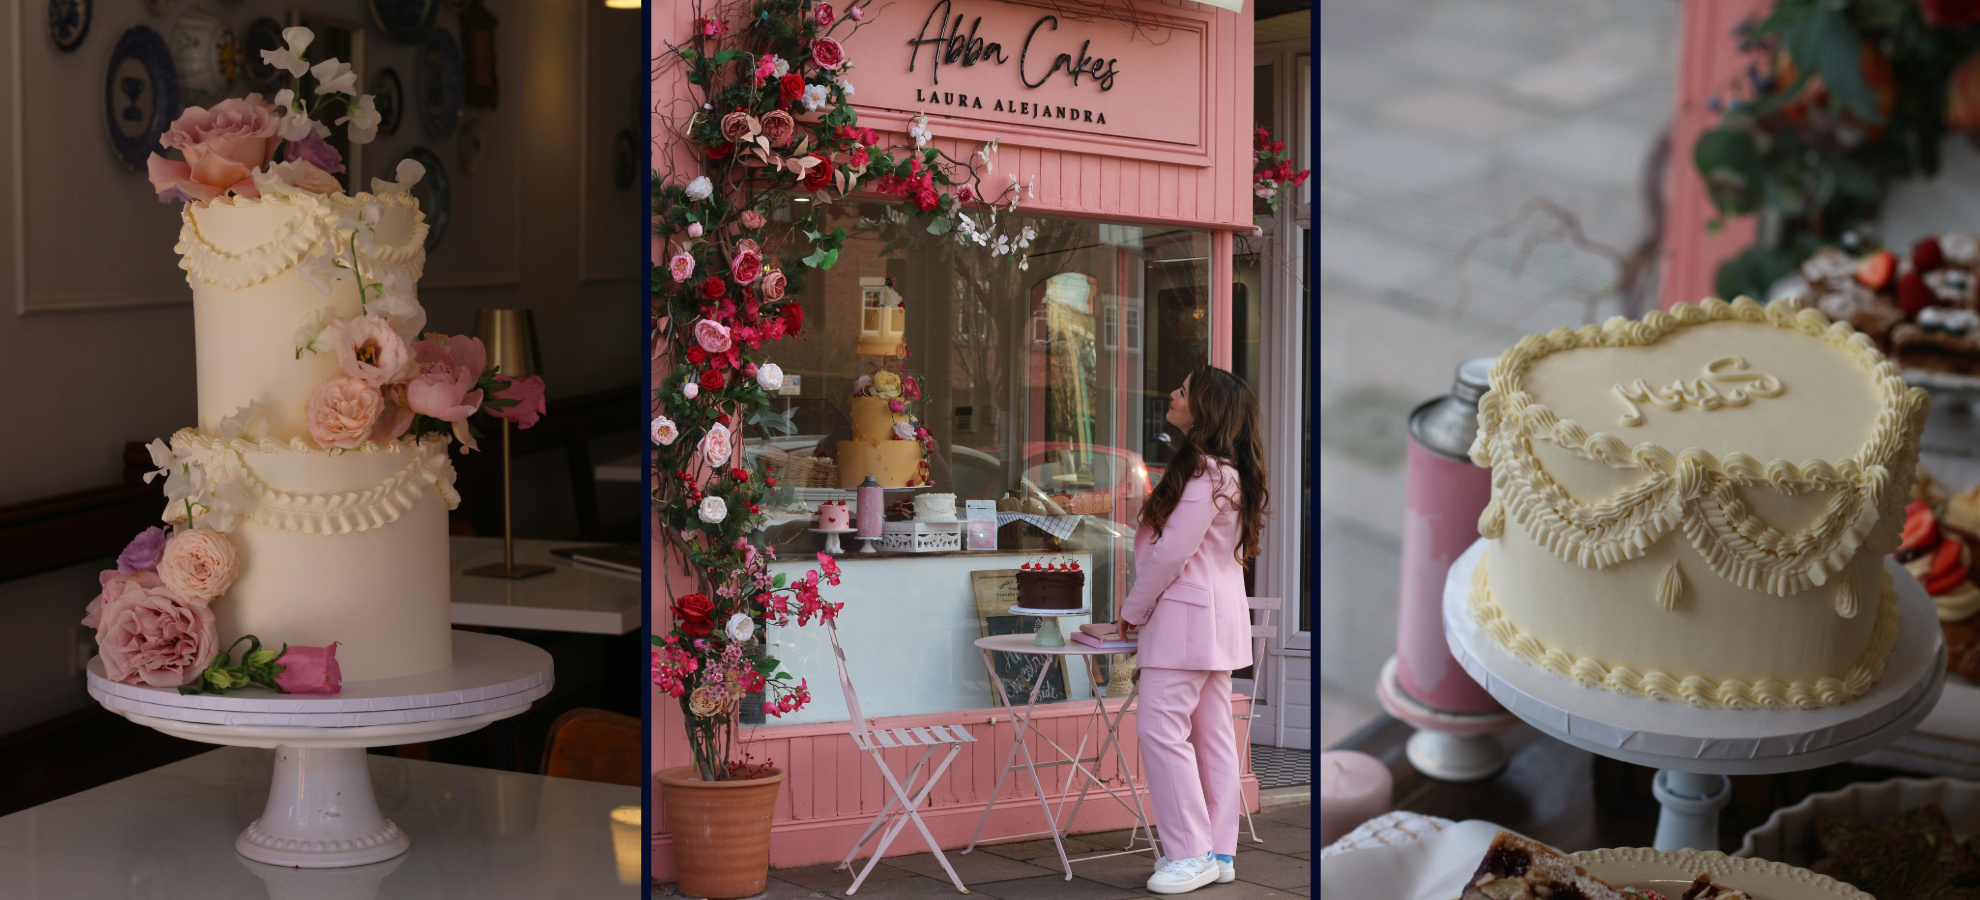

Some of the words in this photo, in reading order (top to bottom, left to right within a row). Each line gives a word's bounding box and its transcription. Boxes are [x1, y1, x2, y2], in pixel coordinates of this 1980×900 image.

[908, 0, 1009, 85] Abba
[1020, 15, 1120, 92] Cakes
[916, 89, 983, 109] LAURA
[994, 98, 1107, 125] ALEJANDRA
